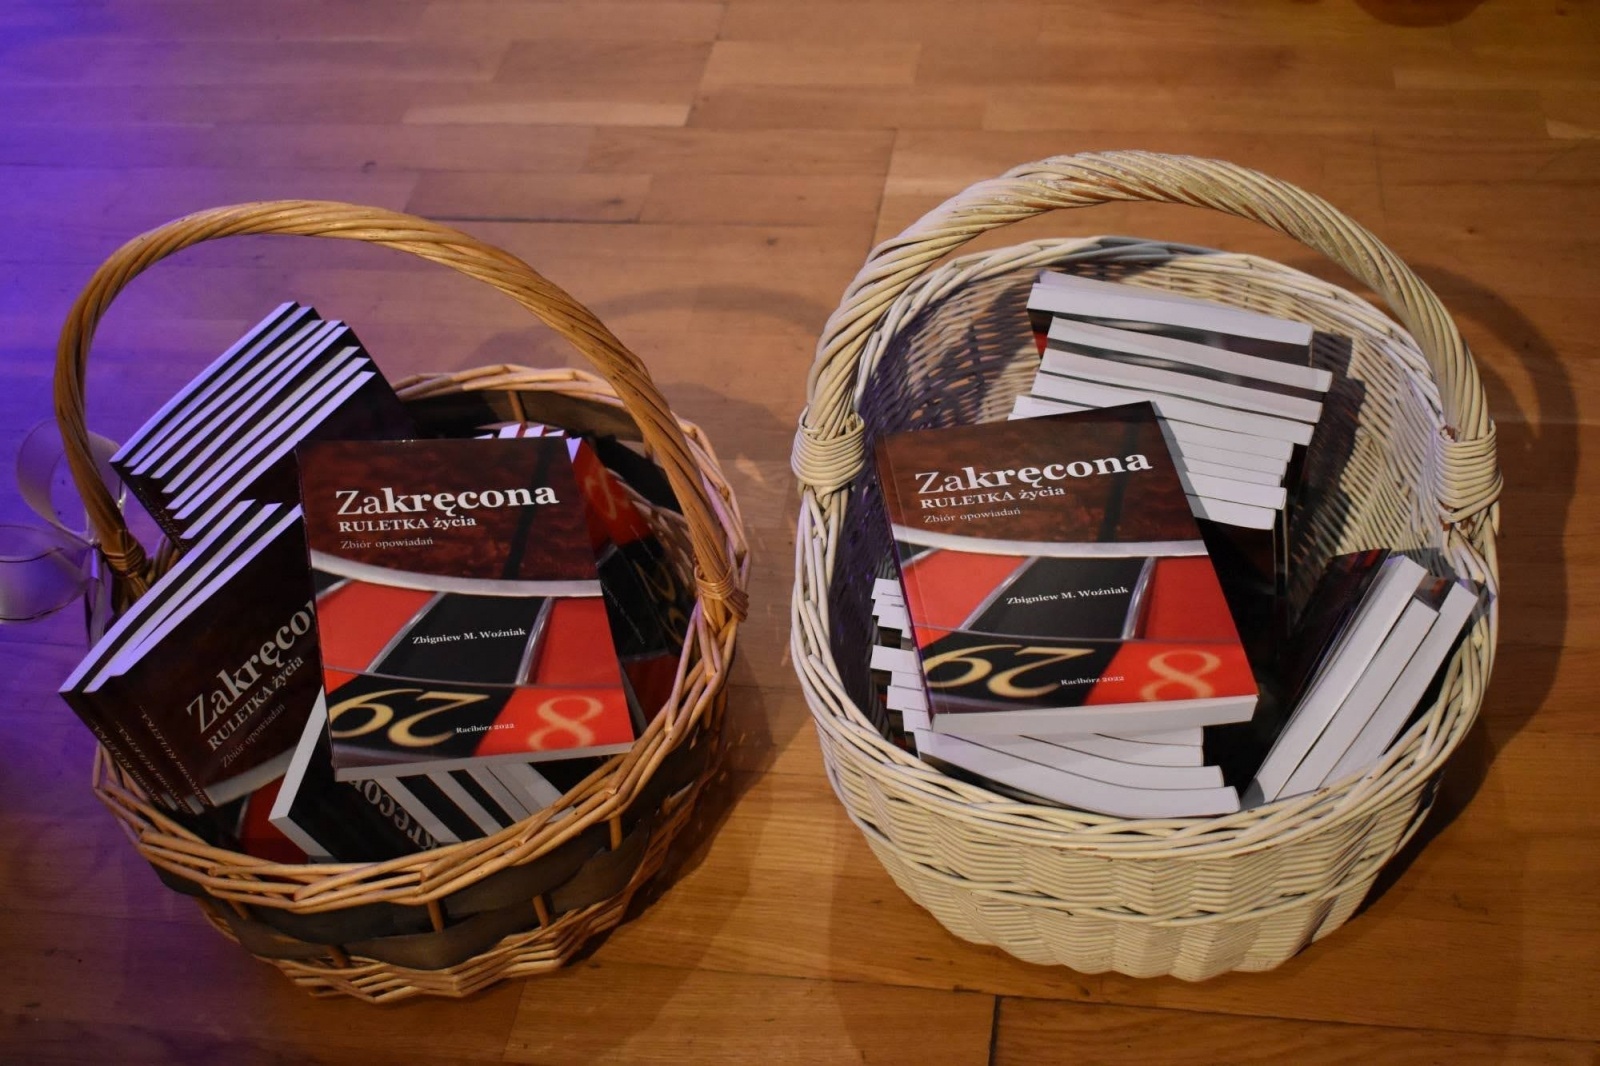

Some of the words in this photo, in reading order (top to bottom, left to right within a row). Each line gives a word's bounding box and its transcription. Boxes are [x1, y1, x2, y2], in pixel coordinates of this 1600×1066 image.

[915, 453, 1153, 494] Zakręcona
[335, 486, 560, 517] Zakręcona
[921, 491, 1015, 509] RULETKA
[1019, 486, 1066, 501] życia
[338, 517, 429, 533] RULETKA
[432, 516, 477, 530] życia
[924, 514, 956, 524] Zbiór
[960, 507, 1021, 521] opowiadań
[341, 539, 371, 549] Zbiór
[375, 536, 434, 549] opowiadań
[1006, 592, 1060, 604] Zbigniew
[1061, 590, 1077, 600] M.
[1078, 586, 1129, 597] Woźniak
[412, 635, 461, 645] Zbigniew
[463, 631, 478, 641] M.
[479, 627, 526, 638] Woźniak
[1060, 676, 1100, 686] Racibórz
[1102, 675, 1125, 683] 2022
[207, 685, 274, 751] RULETKA
[271, 656, 304, 690] życia
[455, 724, 492, 734] Racibórz
[493, 723, 515, 731] 2022
